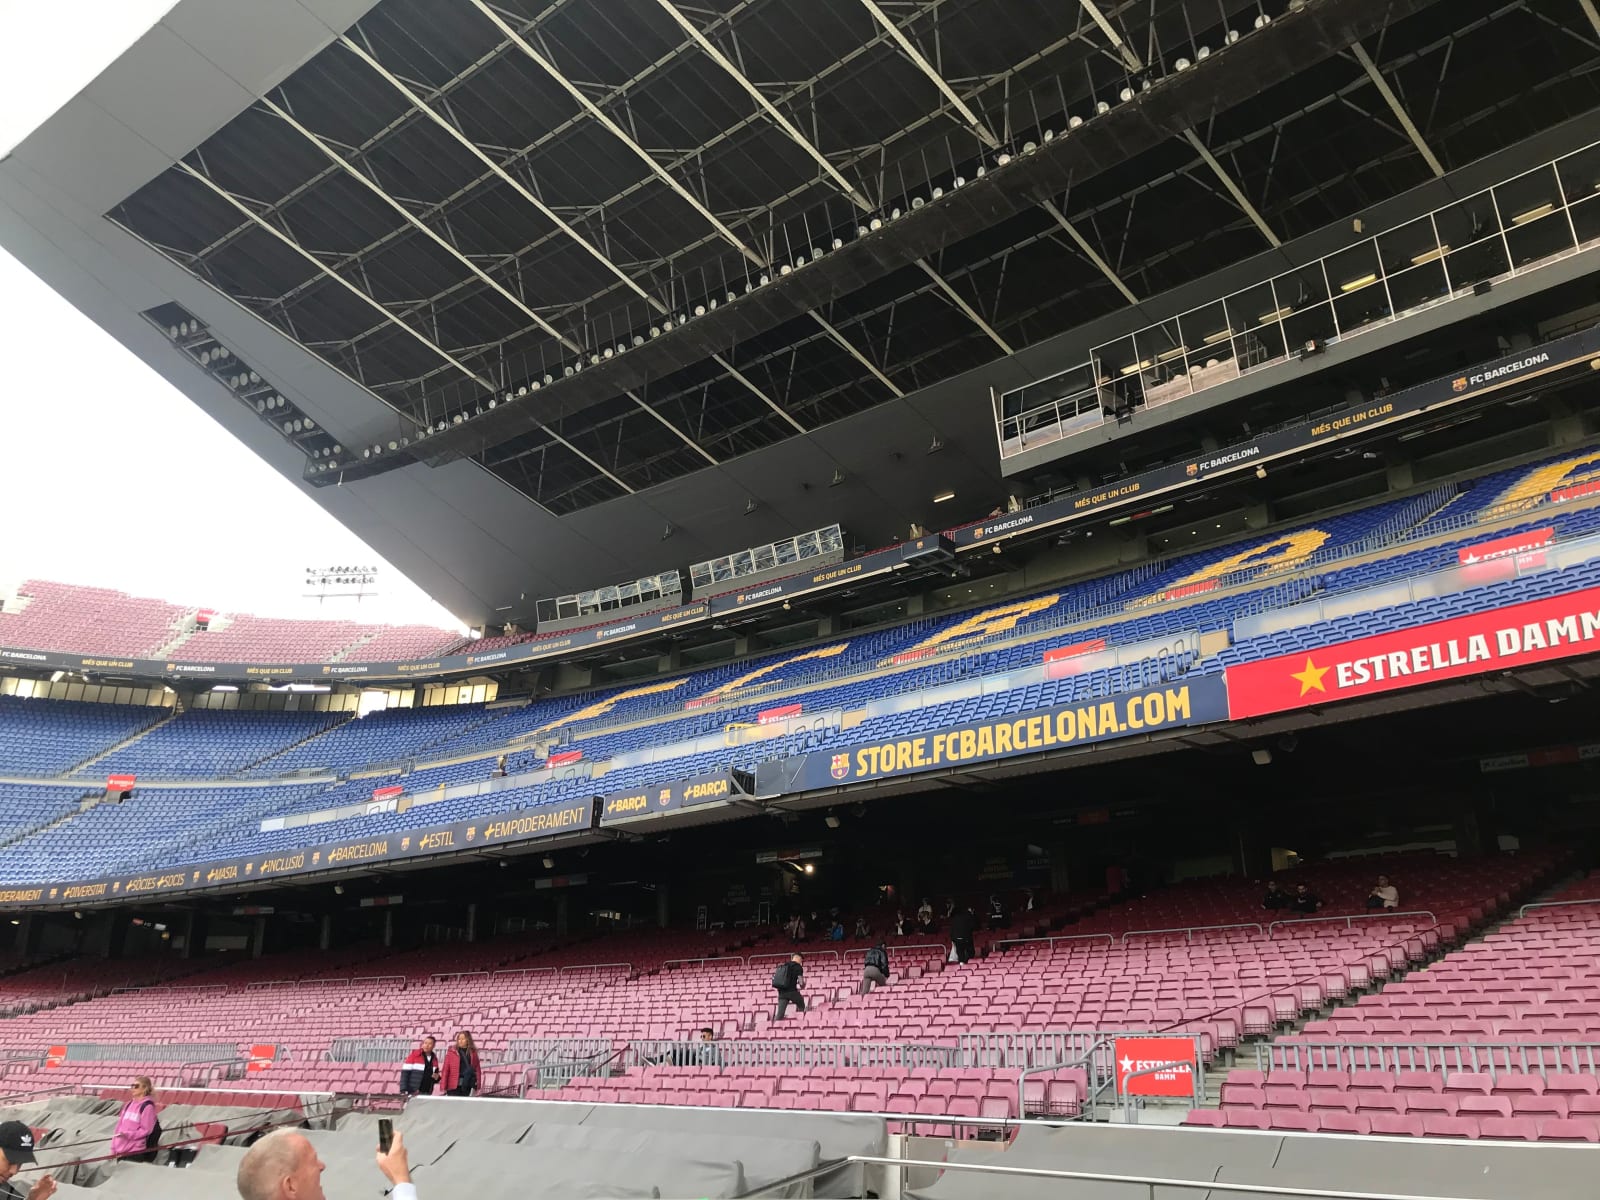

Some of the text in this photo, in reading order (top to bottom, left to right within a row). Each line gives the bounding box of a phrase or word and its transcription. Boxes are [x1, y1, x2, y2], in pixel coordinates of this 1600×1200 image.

[1469, 352, 1549, 385] FC BARCELONA
[1311, 403, 1393, 436] MÉS QUE UN CLUB
[1199, 446, 1260, 471] FC BARCELONA
[1074, 483, 1140, 509] MÉS QUE UN CLUB
[984, 515, 1033, 535] FC BARCELONA
[813, 564, 862, 583] MÉS QUE UN CLUB
[752, 586, 782, 600] BARCELONA
[603, 623, 636, 638] FC BARCELONA
[11, 652, 47, 660] BARCELONA
[480, 652, 507, 662] BARCELONA
[1336, 609, 1600, 689] ESTRELLA DAMM
[856, 686, 1192, 776] STORE.FCBARCELONA.COM
